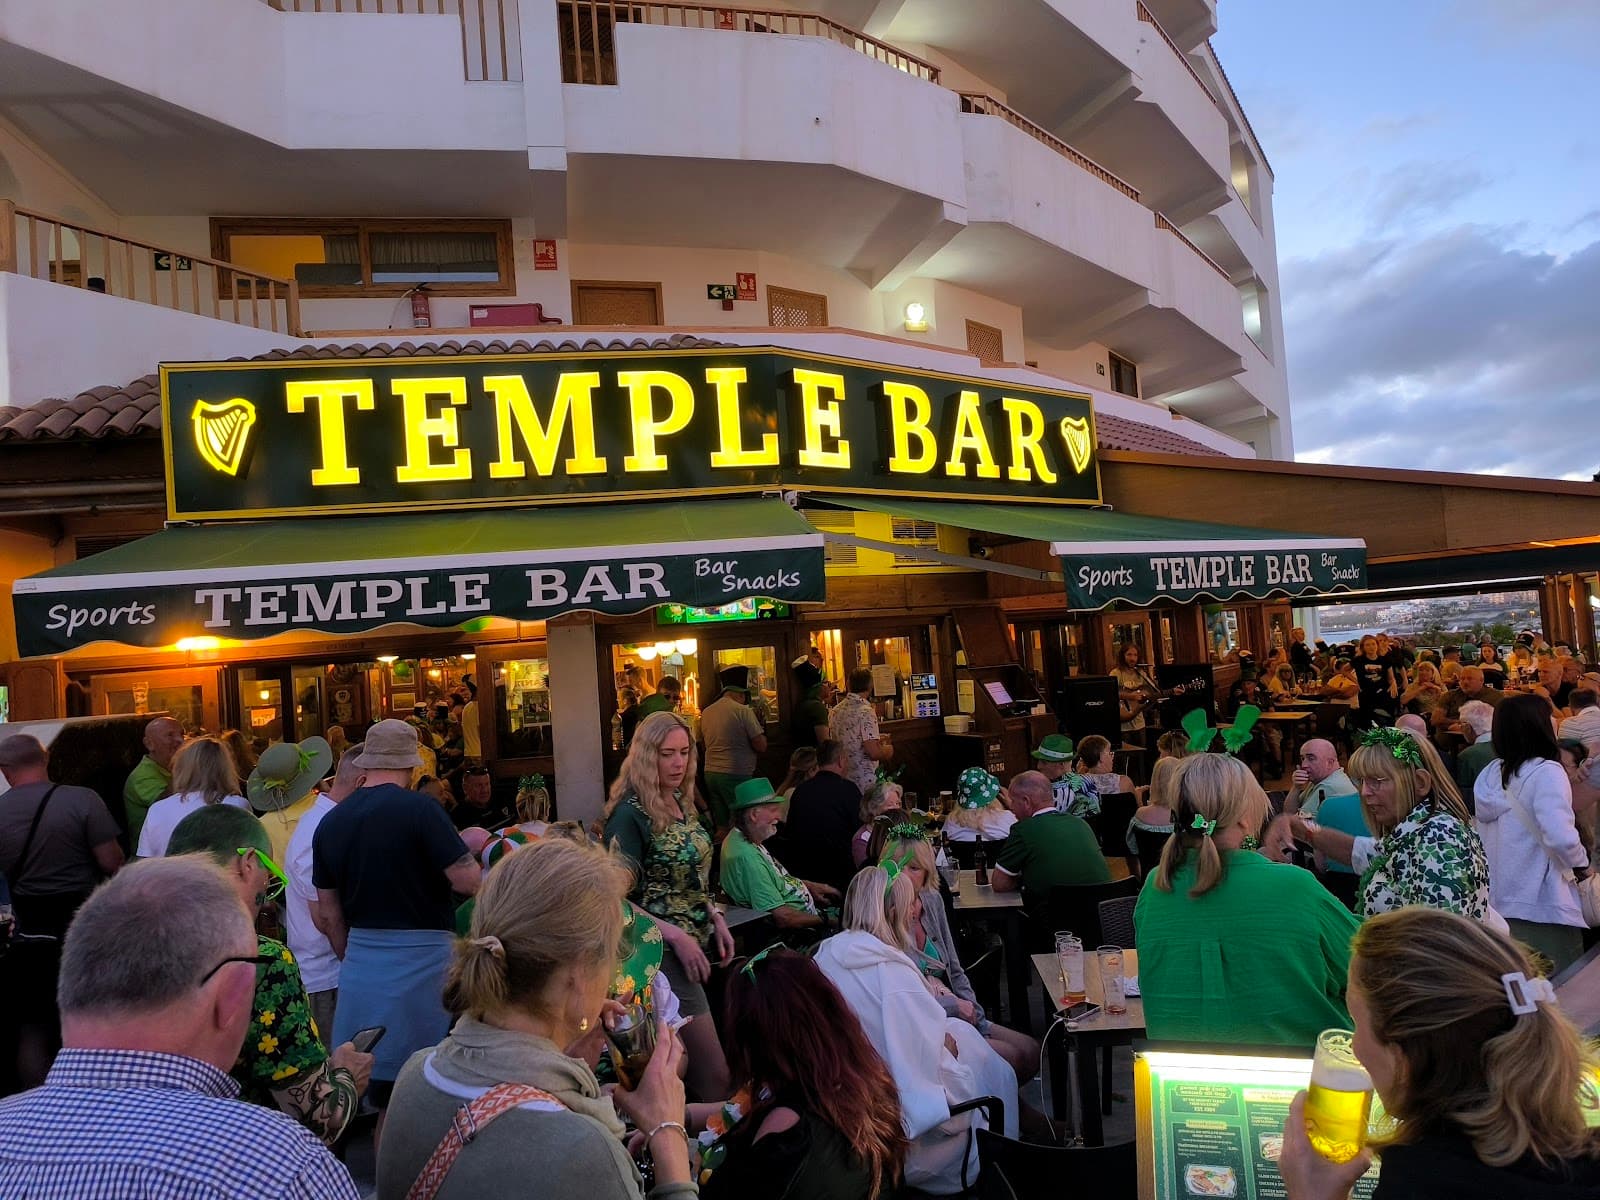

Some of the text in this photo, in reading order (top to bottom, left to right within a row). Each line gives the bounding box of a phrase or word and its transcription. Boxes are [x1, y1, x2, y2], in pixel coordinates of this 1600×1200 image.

[285, 367, 1058, 487] TEMPLE BAR
[694, 557, 738, 577] Bar
[1150, 554, 1313, 591] TEMPLE BAR
[1321, 552, 1338, 567] Bar
[194, 563, 671, 628] TEMPLE BAR
[721, 568, 801, 592] Snacks
[1078, 564, 1134, 595] Sports
[45, 601, 156, 638] Sports
